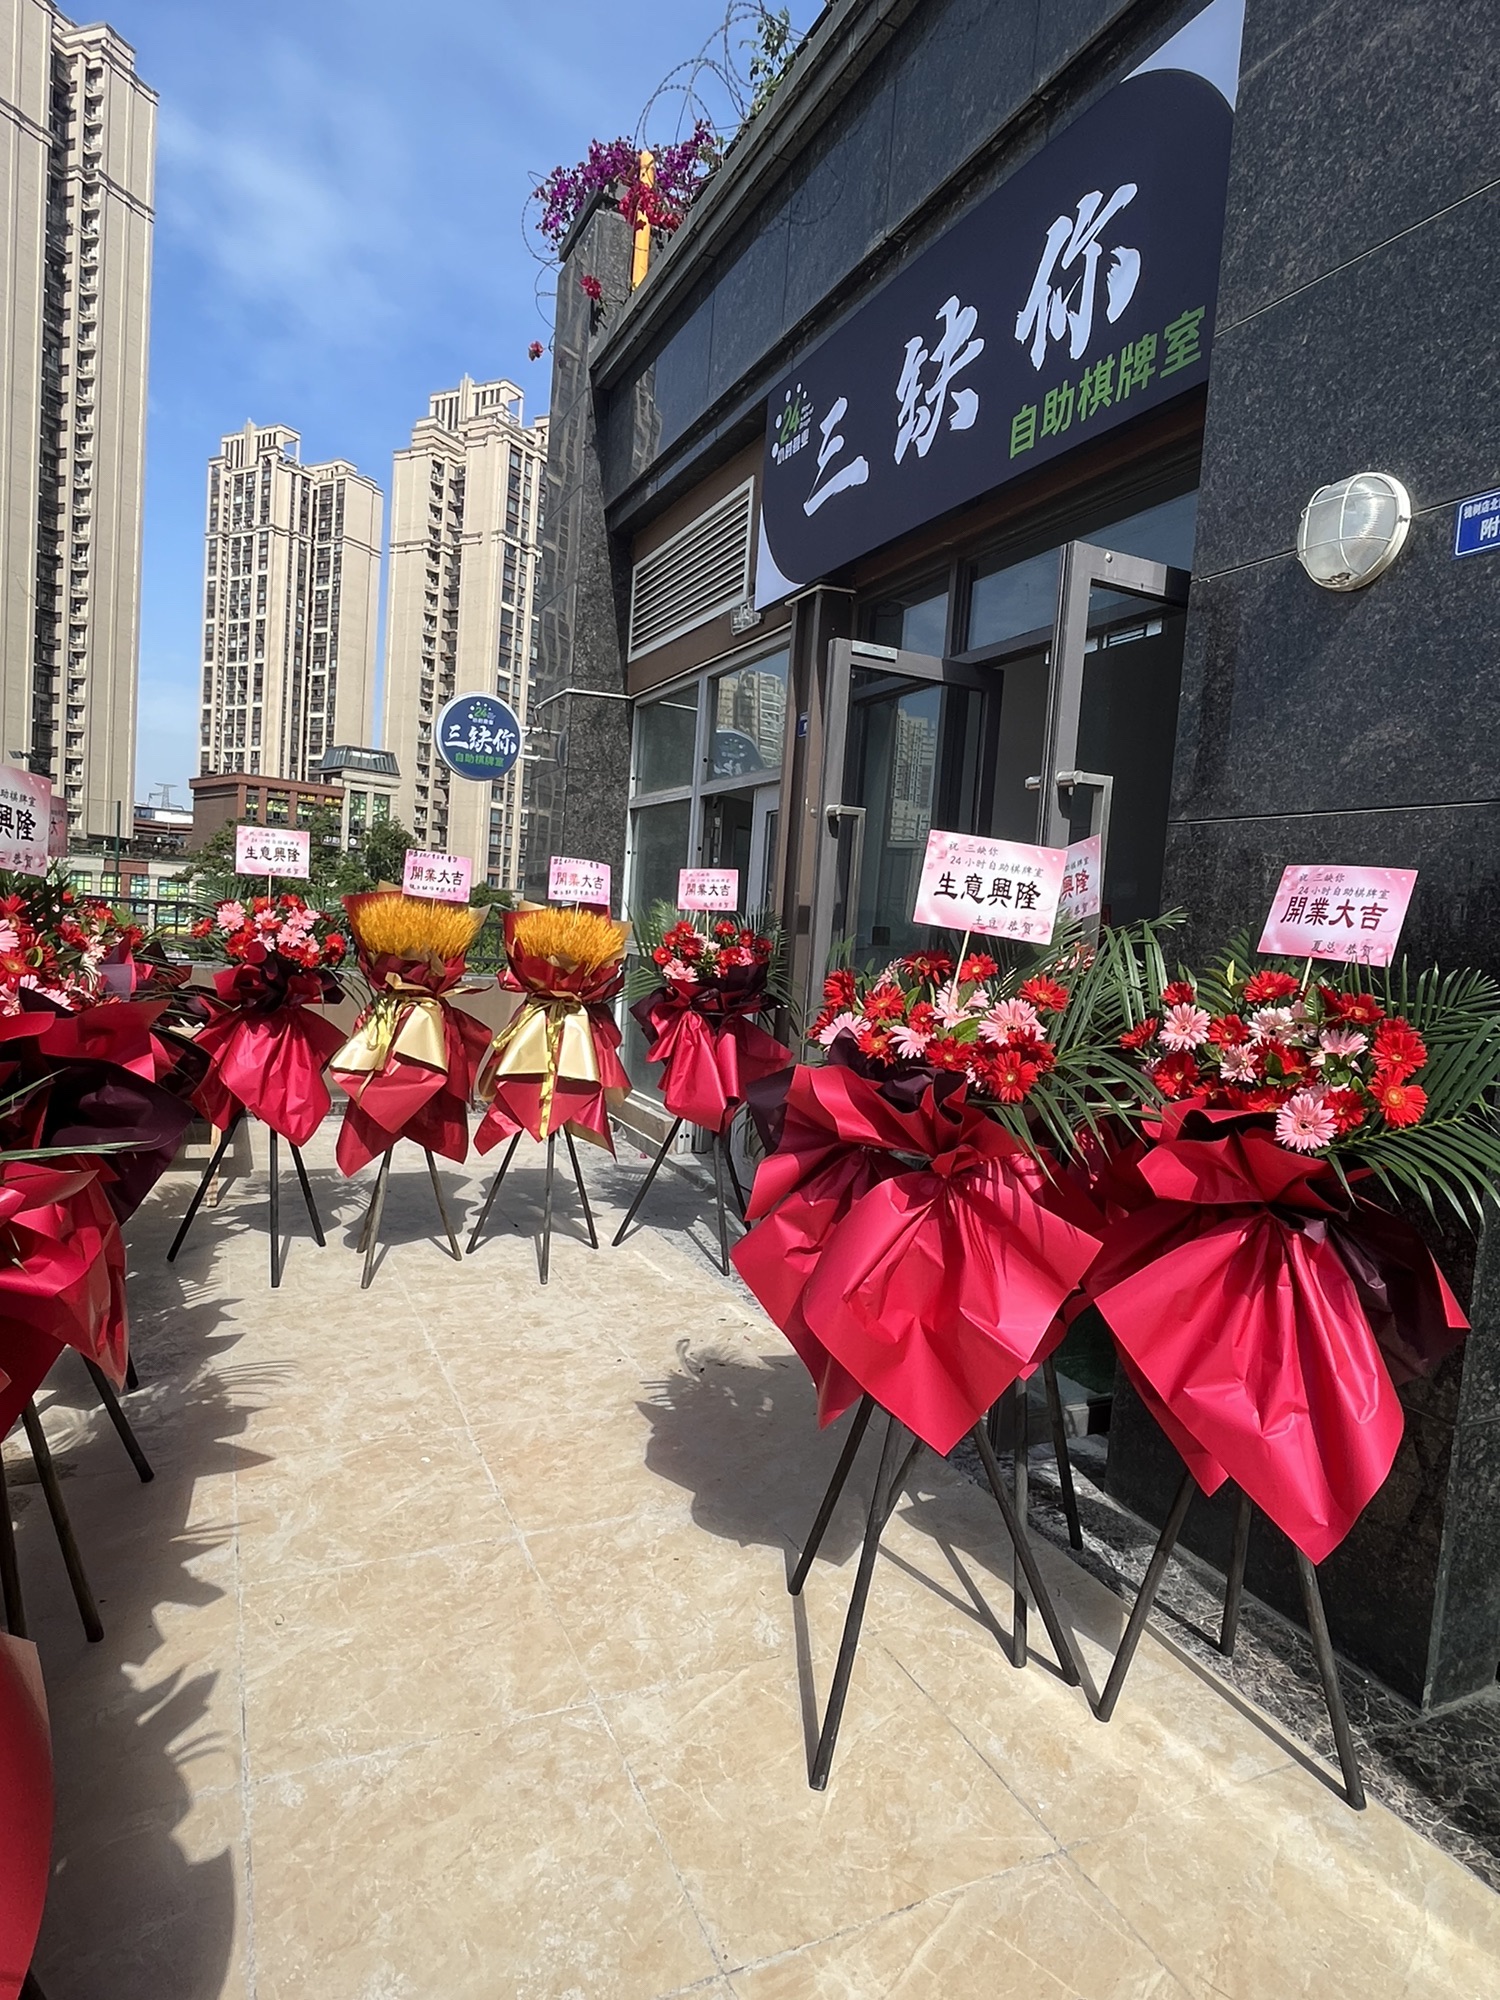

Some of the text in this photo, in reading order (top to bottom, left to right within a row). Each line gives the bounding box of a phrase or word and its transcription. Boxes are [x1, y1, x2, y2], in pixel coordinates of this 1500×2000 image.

[803, 183, 1141, 516] 三缺你
[1009, 305, 1206, 460] 自助棋牌室
[780, 397, 800, 445] 24
[1480, 515, 1500, 541] 附
[444, 724, 517, 755] 三缺你
[965, 844, 999, 857] 三缺你
[934, 871, 1042, 910] 生意興隆
[1313, 873, 1345, 884] 三缺你
[1280, 896, 1389, 931] 開業大吉
